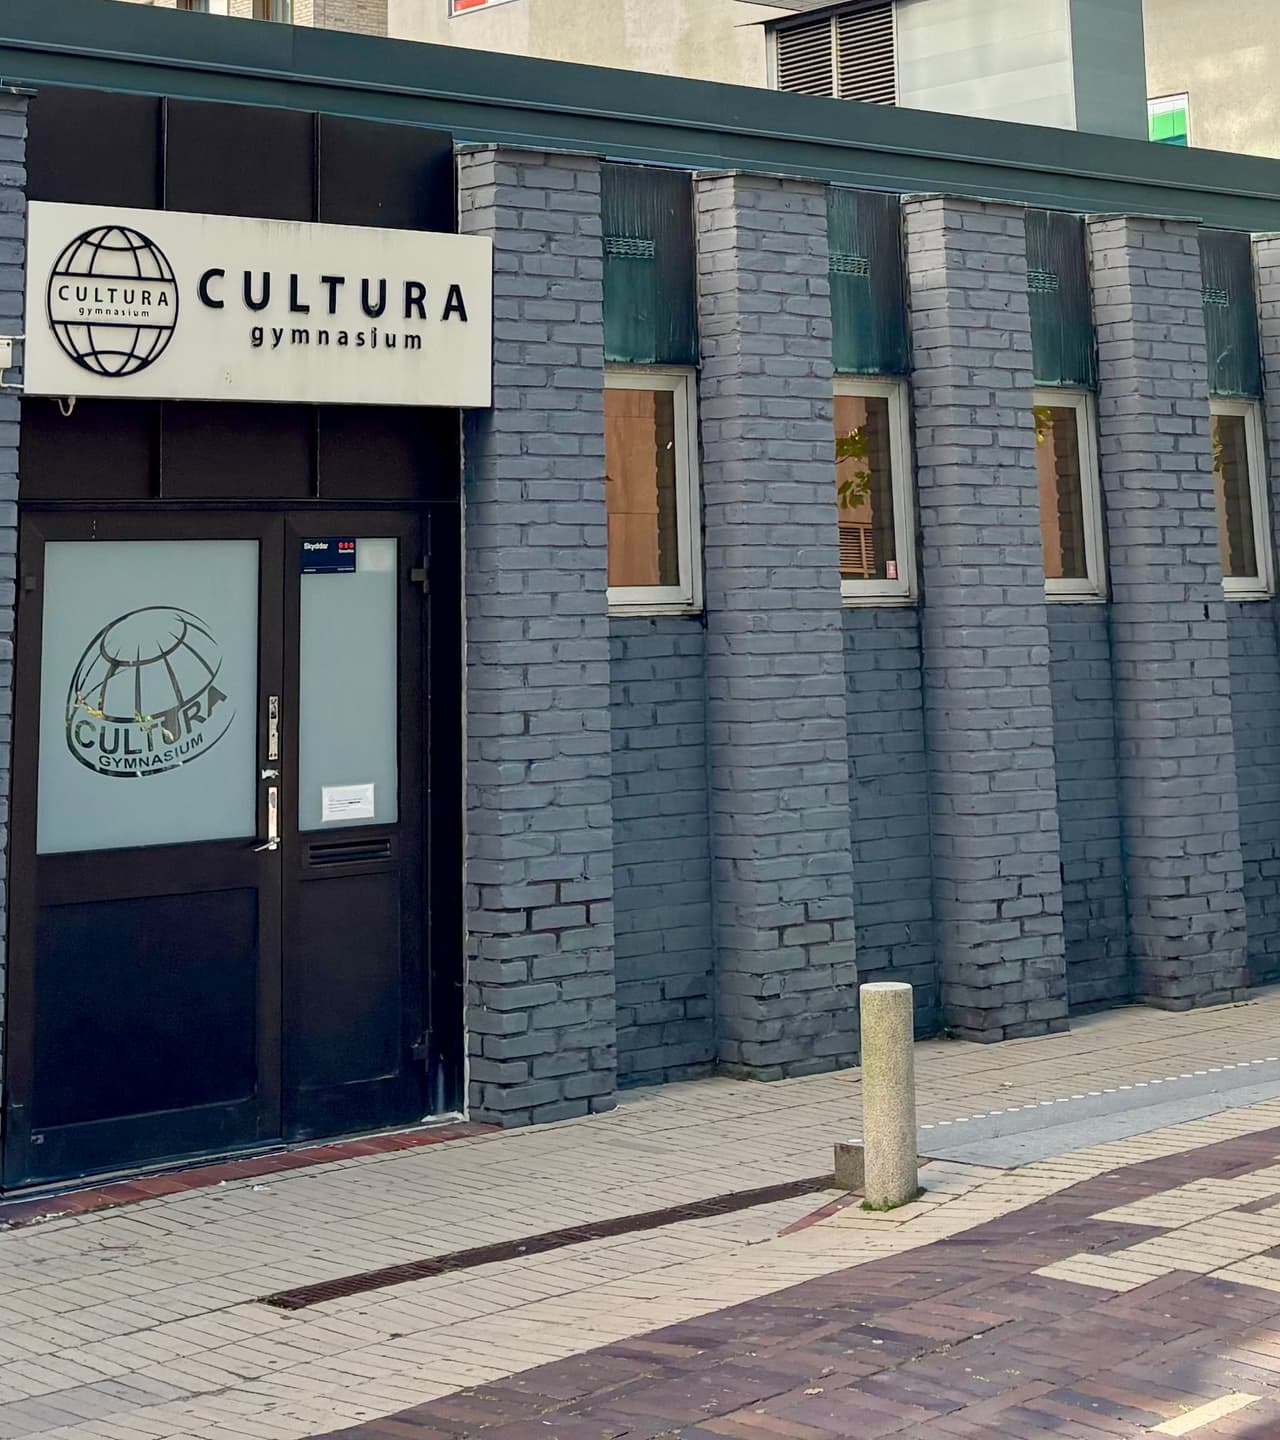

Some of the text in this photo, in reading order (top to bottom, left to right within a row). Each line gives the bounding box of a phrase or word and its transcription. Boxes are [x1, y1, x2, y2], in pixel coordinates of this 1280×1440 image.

[58, 285, 169, 306] CULTURA
[197, 267, 469, 323] CULTURA
[78, 306, 150, 317] gymnasium
[250, 325, 423, 350] gymnasium
[74, 684, 228, 756] CULTURA
[98, 733, 204, 769] GYMNASIUM
